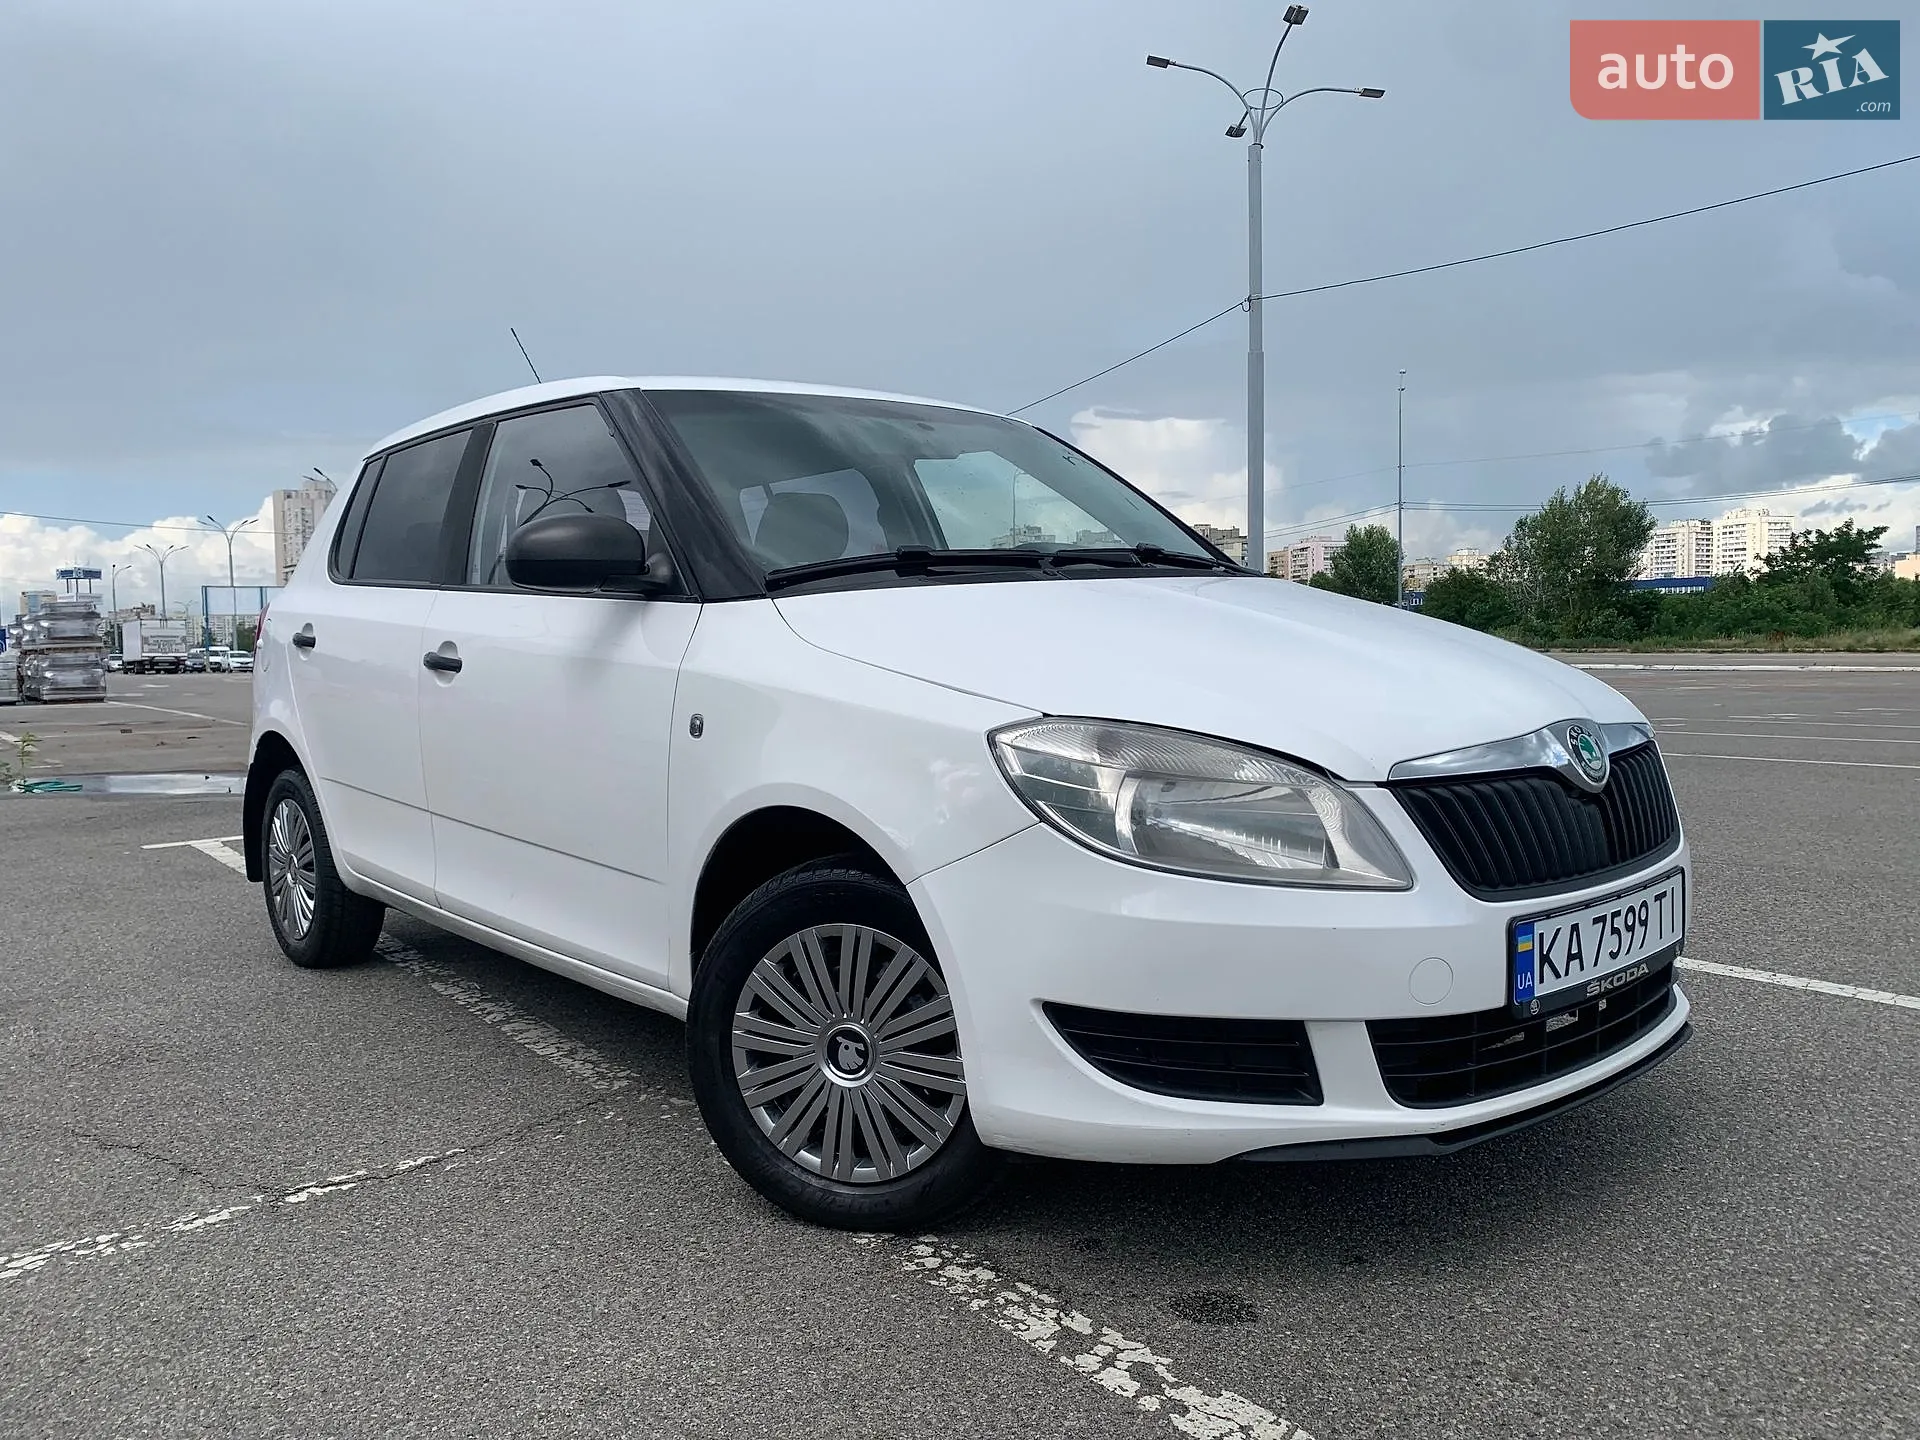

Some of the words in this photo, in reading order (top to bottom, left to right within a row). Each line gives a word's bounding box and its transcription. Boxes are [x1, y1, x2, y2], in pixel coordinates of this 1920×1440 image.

[1538, 922, 1585, 985] KA
[1592, 899, 1649, 968] 7599
[1654, 886, 1675, 941] TI
[1517, 971, 1533, 990] UA
